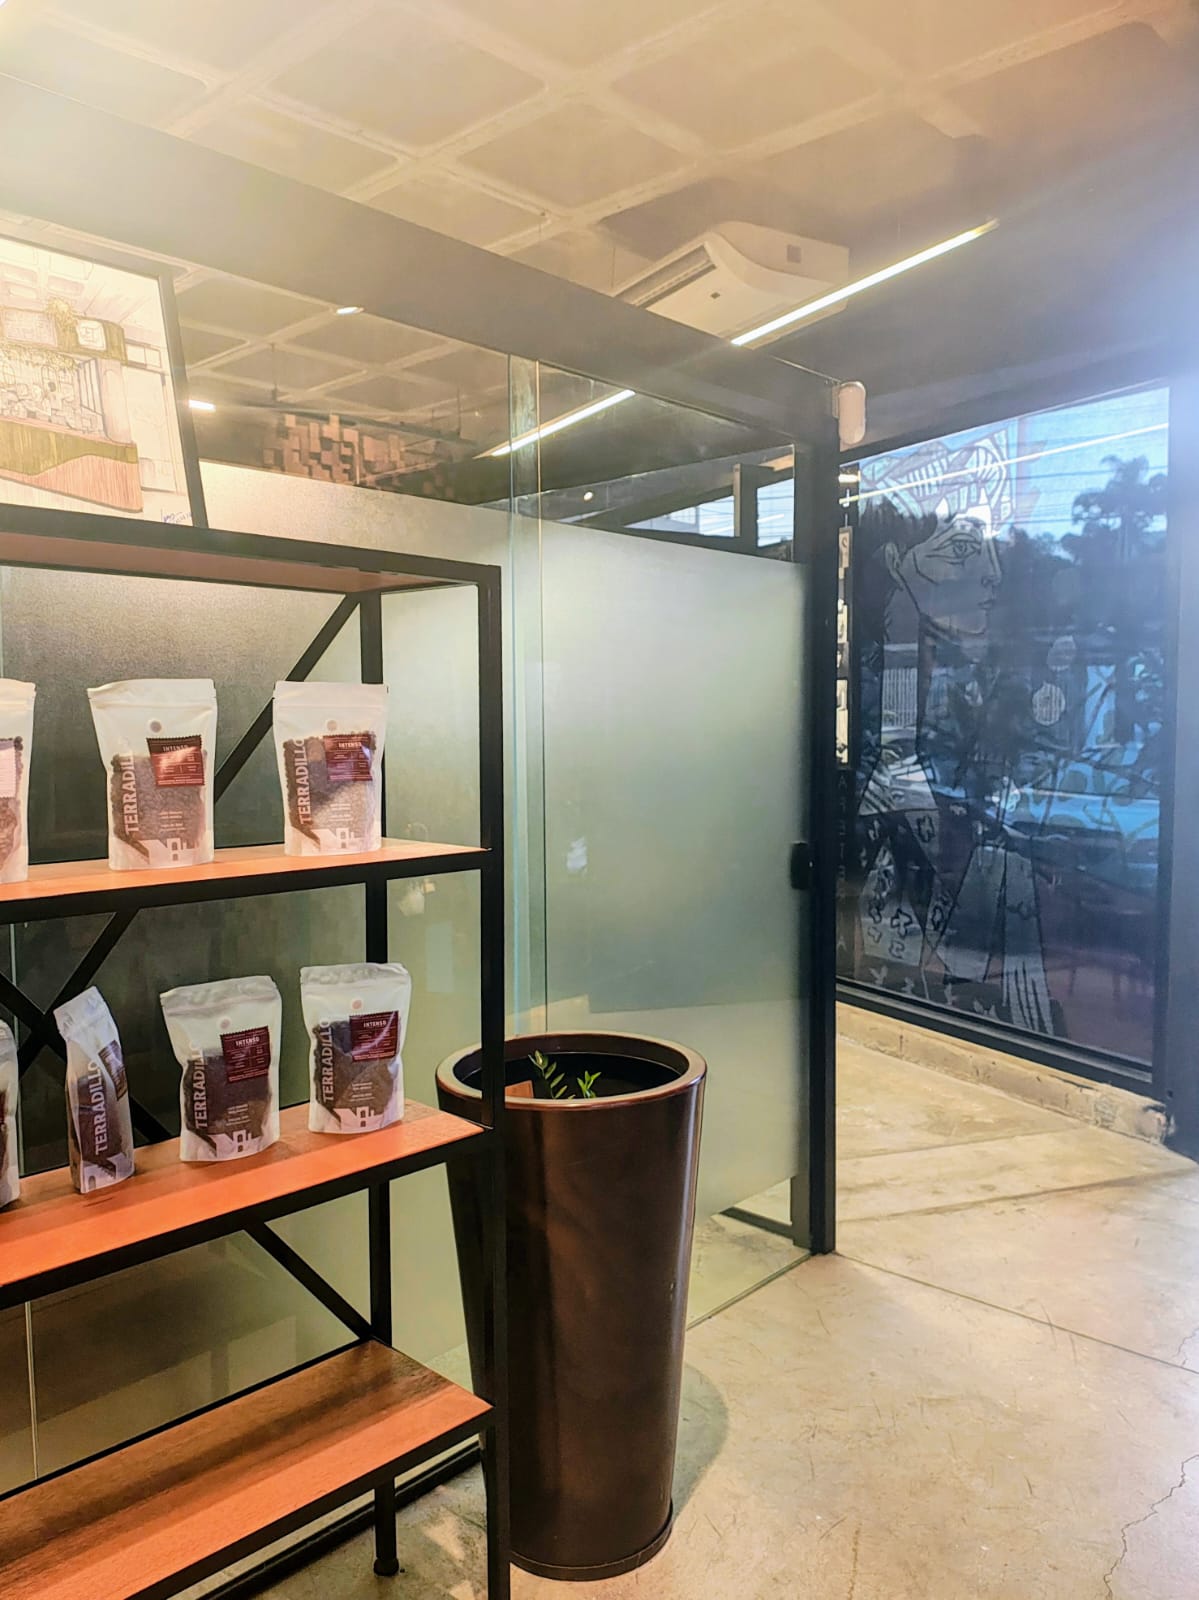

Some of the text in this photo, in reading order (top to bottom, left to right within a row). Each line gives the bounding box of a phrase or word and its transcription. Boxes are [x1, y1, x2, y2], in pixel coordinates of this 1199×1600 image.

[293, 737, 312, 824] TERRADILLO
[235, 1036, 260, 1046] INTENSO
[321, 1021, 334, 1102] TERRADILLO
[88, 1060, 108, 1155] TERRADILLO
